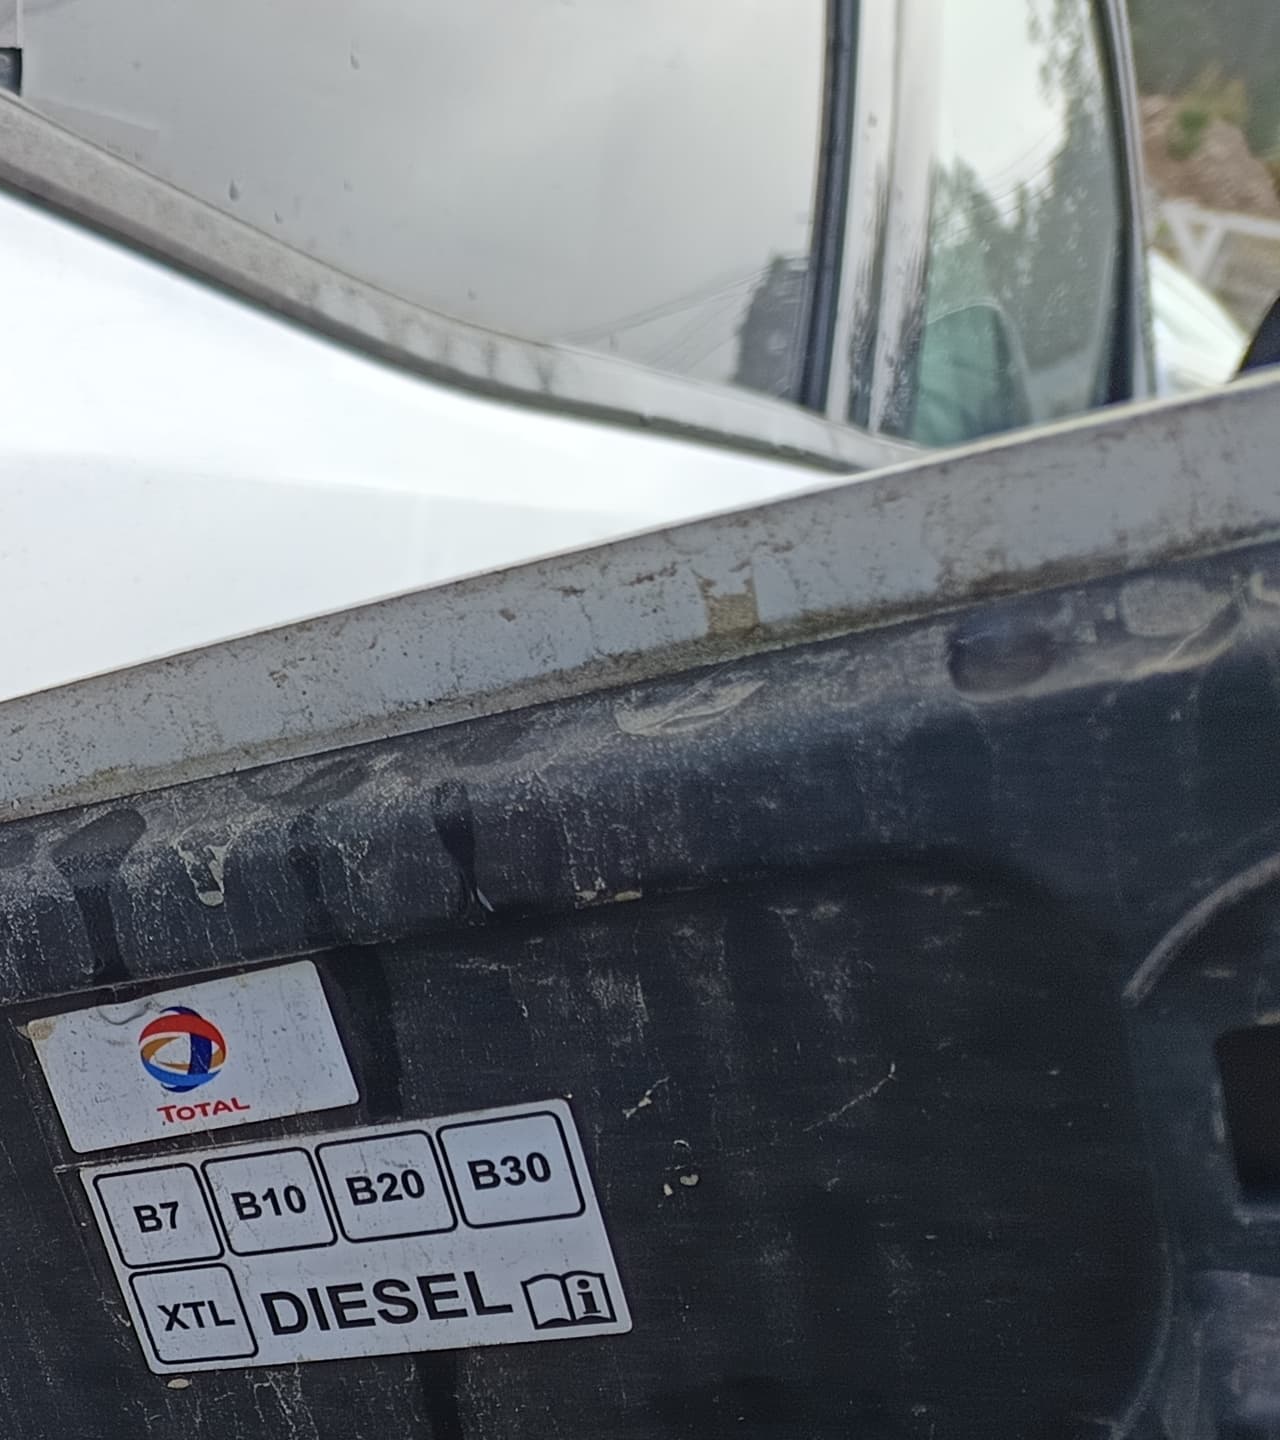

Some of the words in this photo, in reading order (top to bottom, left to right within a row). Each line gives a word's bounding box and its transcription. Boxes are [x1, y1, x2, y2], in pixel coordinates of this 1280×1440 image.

[157, 1097, 250, 1125] TOTAL
[133, 1202, 180, 1233] B7
[231, 1185, 307, 1221] B10
[345, 1168, 426, 1205] B20
[467, 1151, 552, 1190] B30
[157, 1300, 236, 1332] XTL
[260, 1270, 514, 1336] DIESEL
